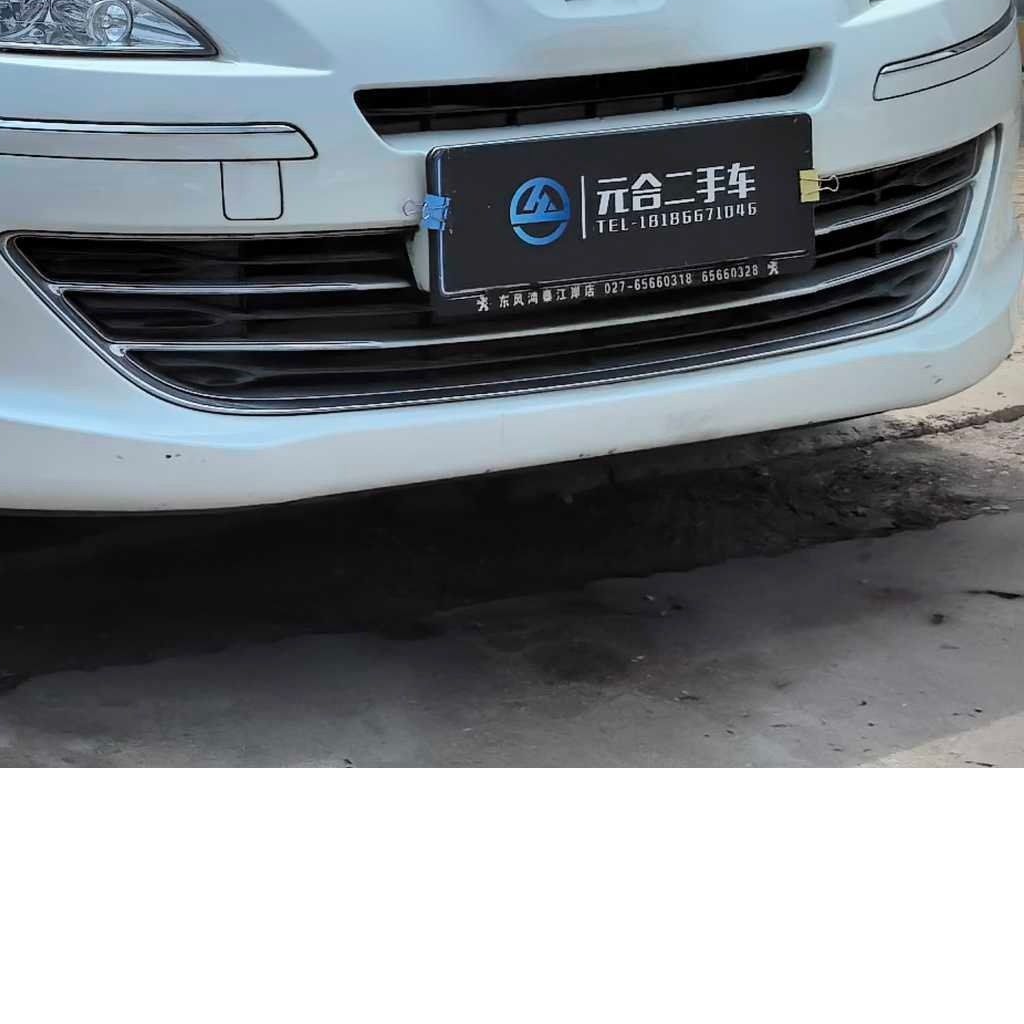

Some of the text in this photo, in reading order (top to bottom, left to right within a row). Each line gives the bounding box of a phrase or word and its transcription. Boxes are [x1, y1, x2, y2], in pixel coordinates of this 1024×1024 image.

[596, 162, 756, 215] 元合二手车
